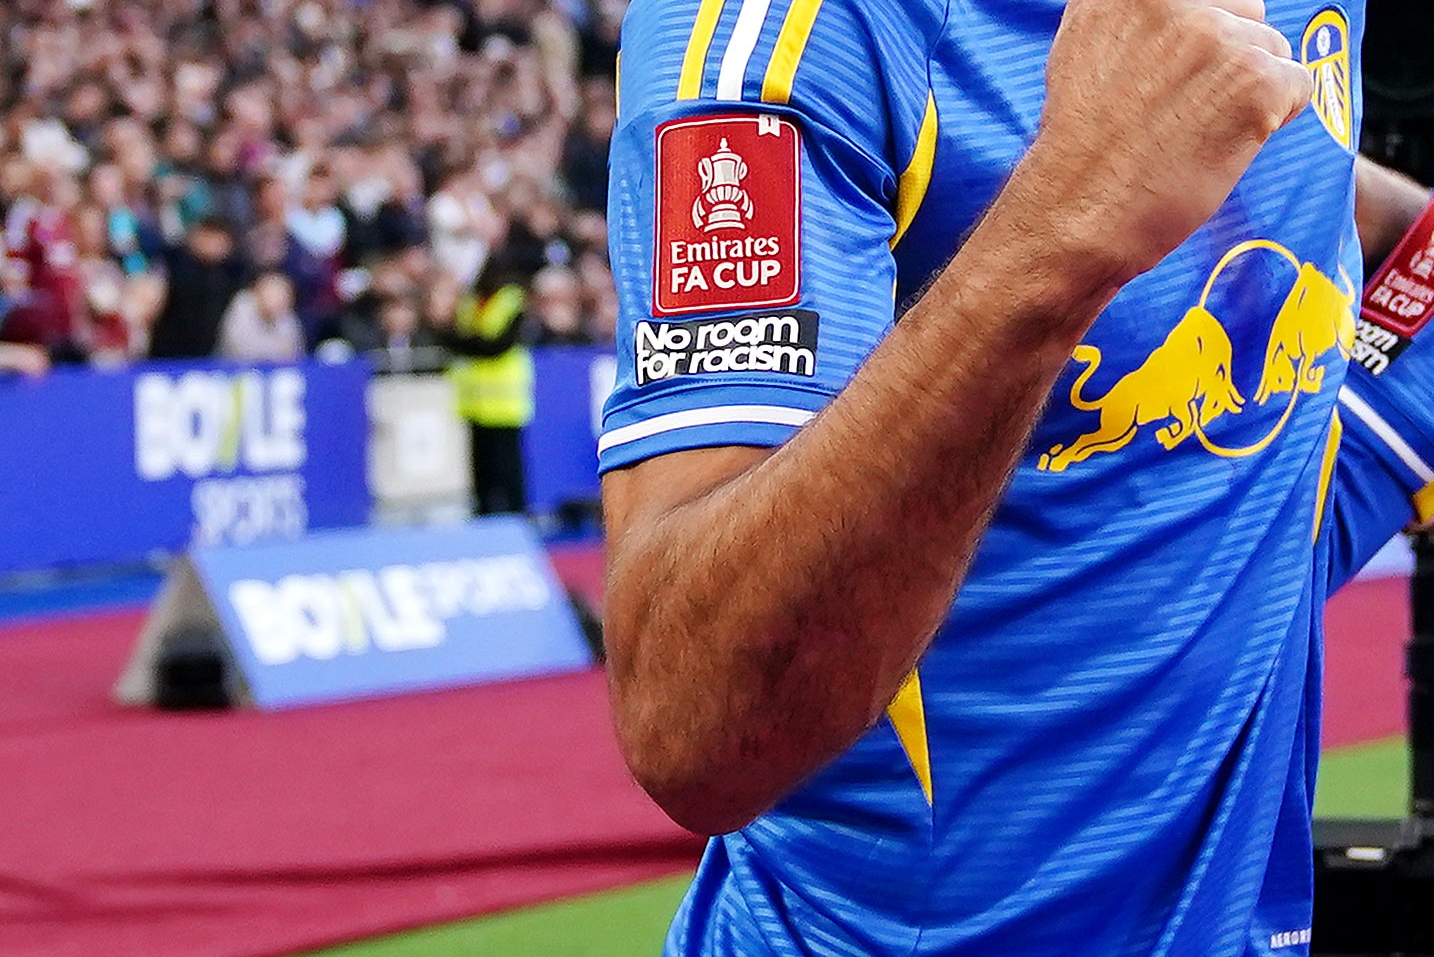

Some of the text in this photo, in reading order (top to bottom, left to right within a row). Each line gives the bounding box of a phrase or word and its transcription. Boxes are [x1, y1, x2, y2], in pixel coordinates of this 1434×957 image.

[670, 235, 780, 265] Emirates
[670, 259, 782, 294] FA CUP
[1388, 293, 1426, 318] CUP
[636, 315, 800, 354] No room
[636, 344, 816, 386] for racism
